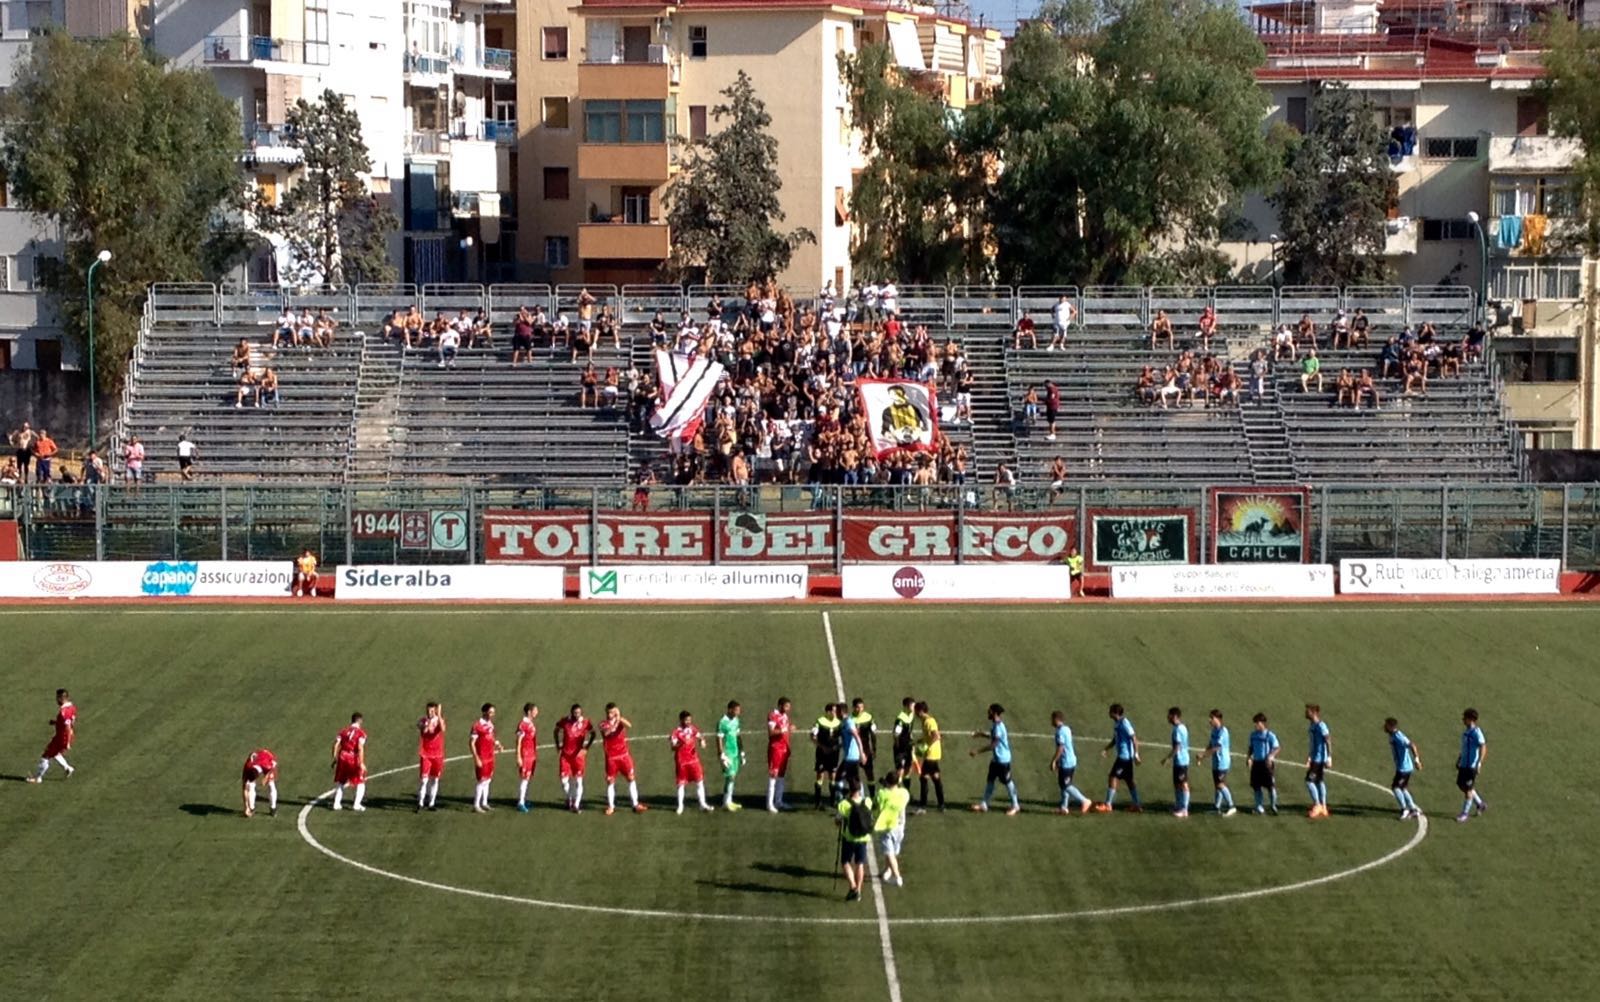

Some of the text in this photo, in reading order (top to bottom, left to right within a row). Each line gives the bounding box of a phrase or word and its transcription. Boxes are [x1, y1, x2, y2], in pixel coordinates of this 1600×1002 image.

[353, 513, 400, 534] 1944
[440, 518, 460, 540] T
[490, 523, 1068, 557] TORRE DEL GRECO
[143, 570, 195, 588] capano
[200, 569, 291, 585] assicurazioni
[345, 569, 452, 587] Sideralba
[721, 569, 803, 586] alluminio
[893, 575, 926, 588] amis
[1375, 563, 1555, 583] Rubnacci Falegameria
